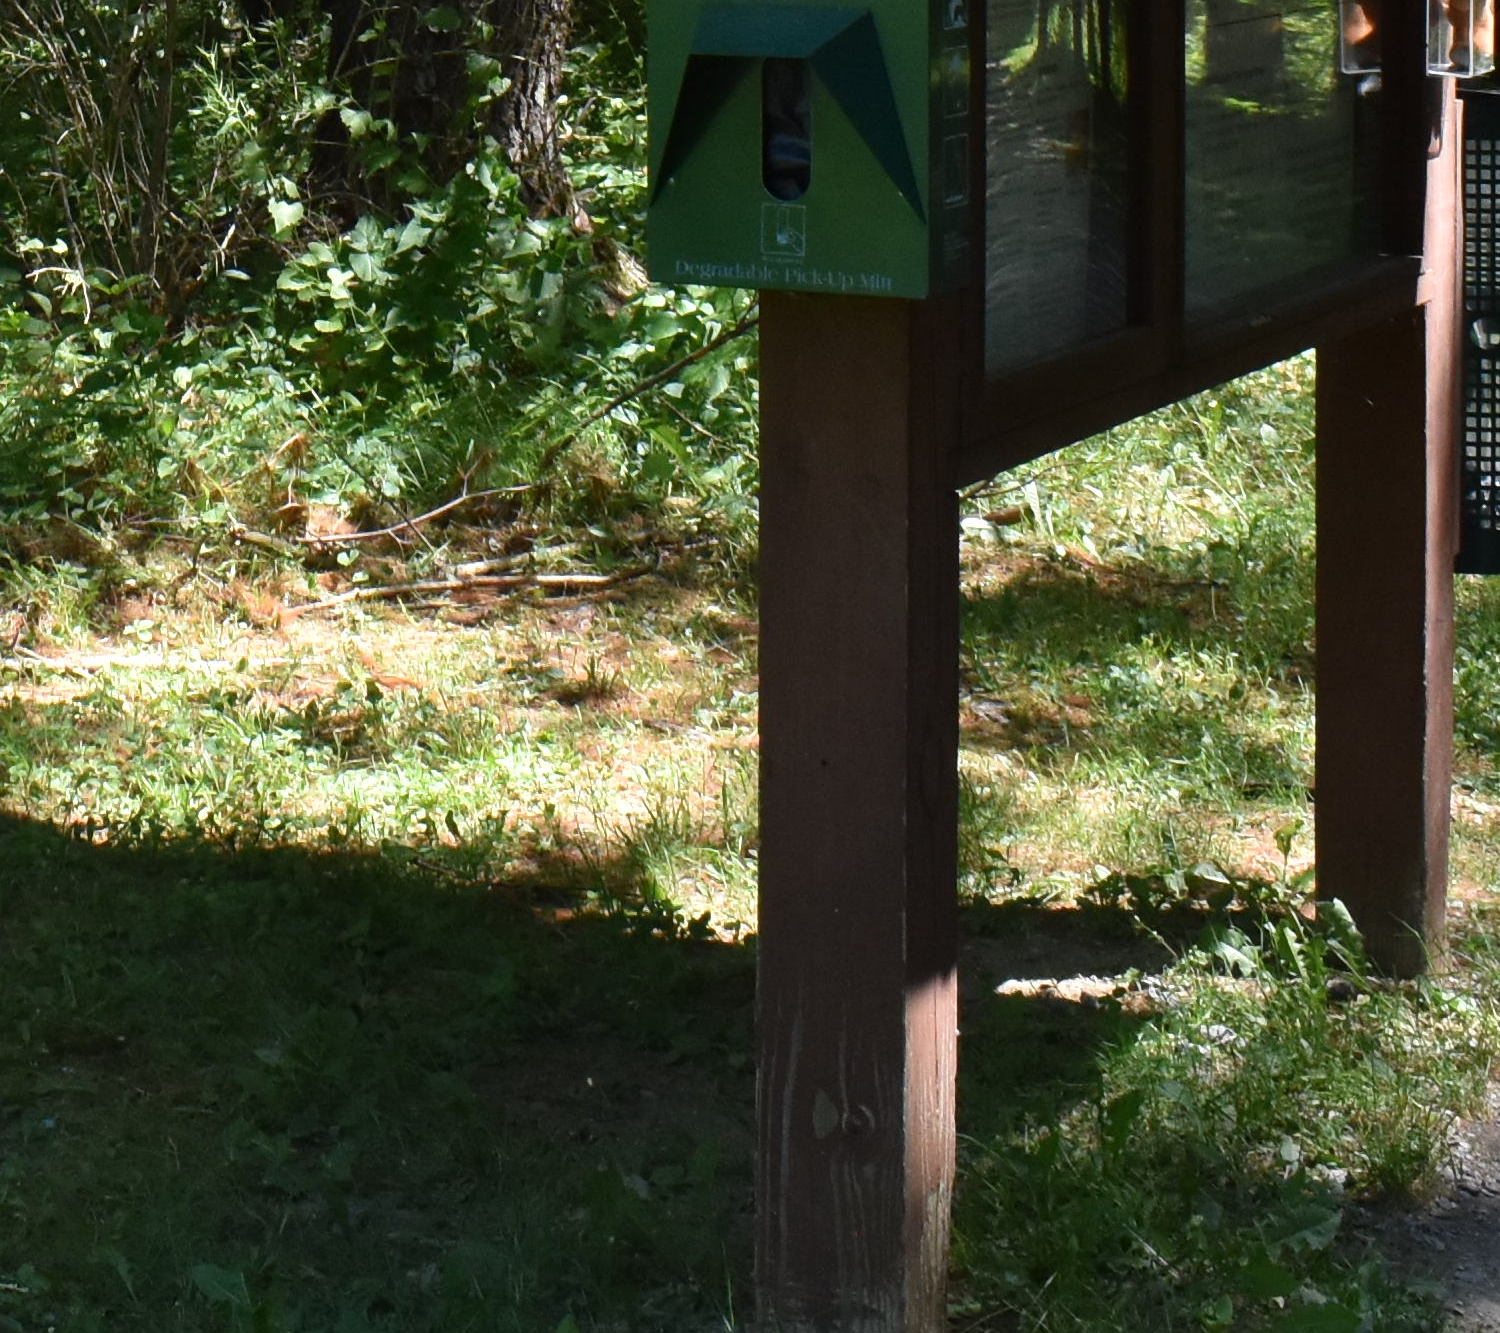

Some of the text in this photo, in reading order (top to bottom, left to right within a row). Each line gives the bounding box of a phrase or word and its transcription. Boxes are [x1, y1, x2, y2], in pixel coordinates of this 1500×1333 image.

[675, 259, 893, 291] Degradable Pick-Up Mitt
